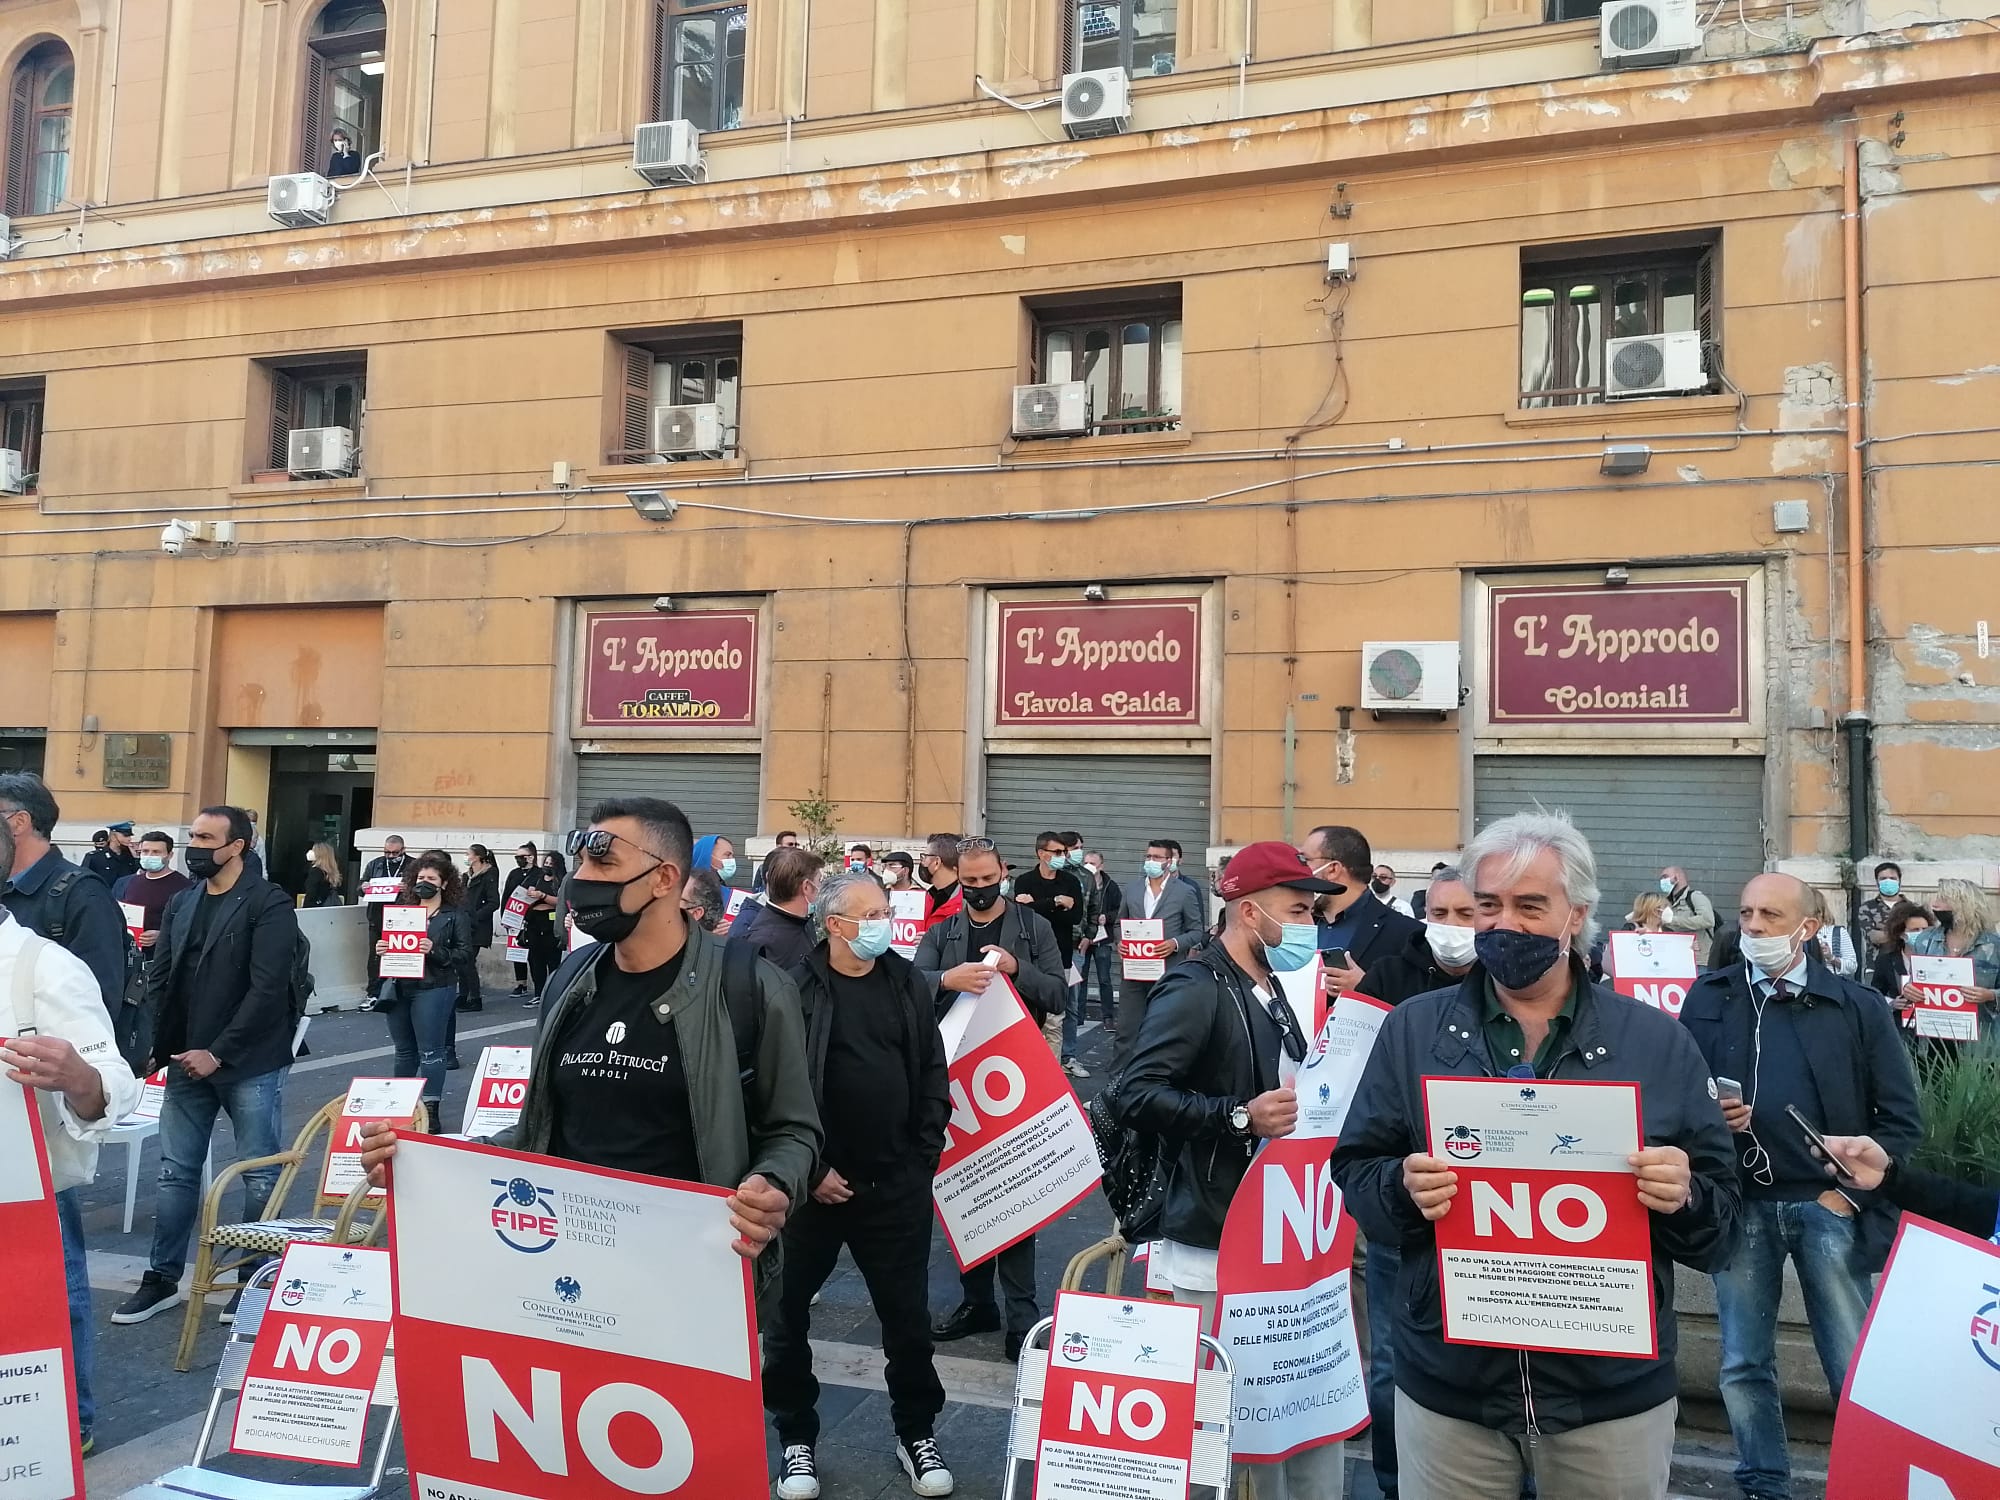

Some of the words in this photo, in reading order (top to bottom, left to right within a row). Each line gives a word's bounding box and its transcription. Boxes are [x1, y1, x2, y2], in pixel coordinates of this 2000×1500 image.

[1514, 615, 1548, 656] L'
[1558, 614, 1719, 663] Approdo
[603, 637, 626, 672] L'
[632, 637, 742, 677] Approdo
[1017, 627, 1044, 664] L'
[1052, 627, 1180, 671] Approdo
[1015, 691, 1093, 717] Tavola
[1101, 691, 1181, 716] Calda
[1545, 684, 1688, 713] Coloniali
[619, 701, 720, 718] TORALDO
[509, 900, 524, 912] NO
[893, 923, 916, 942] NO
[388, 934, 418, 950] NO
[512, 938, 518, 946] N
[1129, 943, 1156, 957] NO
[1634, 984, 1686, 1013] NO
[1923, 987, 1964, 1008] NO
[560, 1053, 603, 1066] PALAZZO
[581, 1069, 628, 1080] NAPOLI
[488, 1083, 525, 1104] NO
[943, 1055, 1026, 1152] NO
[935, 1181, 943, 1191] NO
[944, 1177, 951, 1186] AD
[951, 1170, 963, 1182] UNA
[963, 1162, 977, 1173] SOLA
[1002, 1119, 1046, 1147] COMMERCIALE
[1046, 1103, 1070, 1122] CHIUSA!
[965, 1173, 973, 1181] AD
[974, 1167, 982, 1176] UN
[982, 1152, 1012, 1171] MAGGIORE
[1012, 1127, 1049, 1152] CONTROLLO
[1445, 1142, 1482, 1151] FIPE
[944, 1191, 960, 1203] DELLE
[960, 1180, 981, 1194] MISURE
[987, 1151, 1027, 1178] PREVENZIONE
[1028, 1138, 1047, 1154] DELLA
[1048, 1122, 1071, 1140] SALUTE
[968, 1198, 993, 1217] RISPOSTA
[994, 1168, 1043, 1200] ALL'EMERGENZA
[1043, 1145, 1076, 1171] SANITARIA!
[973, 1183, 1002, 1204] ECONOMIA
[1007, 1166, 1031, 1183] SALUTE
[1032, 1149, 1057, 1167] INSIEME
[562, 1192, 642, 1215] FEDERAZIONE
[964, 1154, 1092, 1243] #DICIAMONOALLECHIUSURE
[564, 1204, 616, 1222] ITALIANA
[1263, 1158, 1343, 1264] NO
[1471, 1180, 1607, 1243] NO
[492, 1209, 558, 1237] FIPE
[565, 1217, 616, 1234] PUBBLICI
[566, 1230, 616, 1247] ESERCIZI
[1516, 1269, 1556, 1277] MAGGIORE
[1549, 1264, 1605, 1272] COMMERCIALE
[1517, 1276, 1571, 1286] PREVENZIONE
[281, 1291, 304, 1299] FIPE
[1490, 1290, 1530, 1298] ECONOMIA
[1538, 1293, 1568, 1301] SALUTE
[523, 1301, 616, 1326] CONFCOMMERCIO
[1230, 1309, 1242, 1318] NO
[1245, 1307, 1256, 1317] AD
[1258, 1306, 1275, 1316] UNA
[1278, 1304, 1299, 1314] SOLA
[1515, 1299, 1578, 1310] ALL'EMERGENZA
[1580, 1304, 1623, 1312] SANITARIA!
[556, 1327, 585, 1336] CAMPANIA
[1267, 1320, 1274, 1329] SI
[1277, 1319, 1289, 1328] AD
[1291, 1318, 1300, 1326] UN
[1462, 1313, 1636, 1335] #DICIAMONOALLECHIUSURE
[1971, 1316, 2000, 1346] FI
[1233, 1336, 1261, 1346] DELLE
[1263, 1332, 1292, 1344] MISURE
[1294, 1331, 1300, 1340] DI
[273, 1323, 361, 1375] NO
[1062, 1345, 1088, 1356] FIPE
[1273, 1356, 1310, 1370] ECONOMIA
[1243, 1377, 1254, 1386] IN
[1256, 1373, 1295, 1386] RISPOSTA
[0, 1392, 31, 1406] UTE
[1069, 1380, 1167, 1441] NO
[461, 1354, 694, 1495] NO
[245, 1428, 351, 1448] #DICIAMONOALLECHIUSURE
[1048, 1460, 1064, 1468] DELLE
[1065, 1463, 1085, 1471] MISURE
[1092, 1467, 1131, 1478] PREVENZIONE
[1133, 1472, 1150, 1481] DELLA
[1152, 1475, 1173, 1484] SALUTE
[1093, 1460, 1122, 1470] MAGGIORE
[1123, 1464, 1156, 1475] CONTROLLO
[1118, 1457, 1157, 1468] COMMERCIALE
[1159, 1463, 1182, 1471] CHIUSA!
[427, 1488, 445, 1499] NO
[1060, 1483, 1087, 1492] RISPOSTA
[1071, 1478, 1100, 1487] ECONOMIA
[1106, 1483, 1127, 1491] SALUTE
[1128, 1486, 1151, 1494] INSIEME
